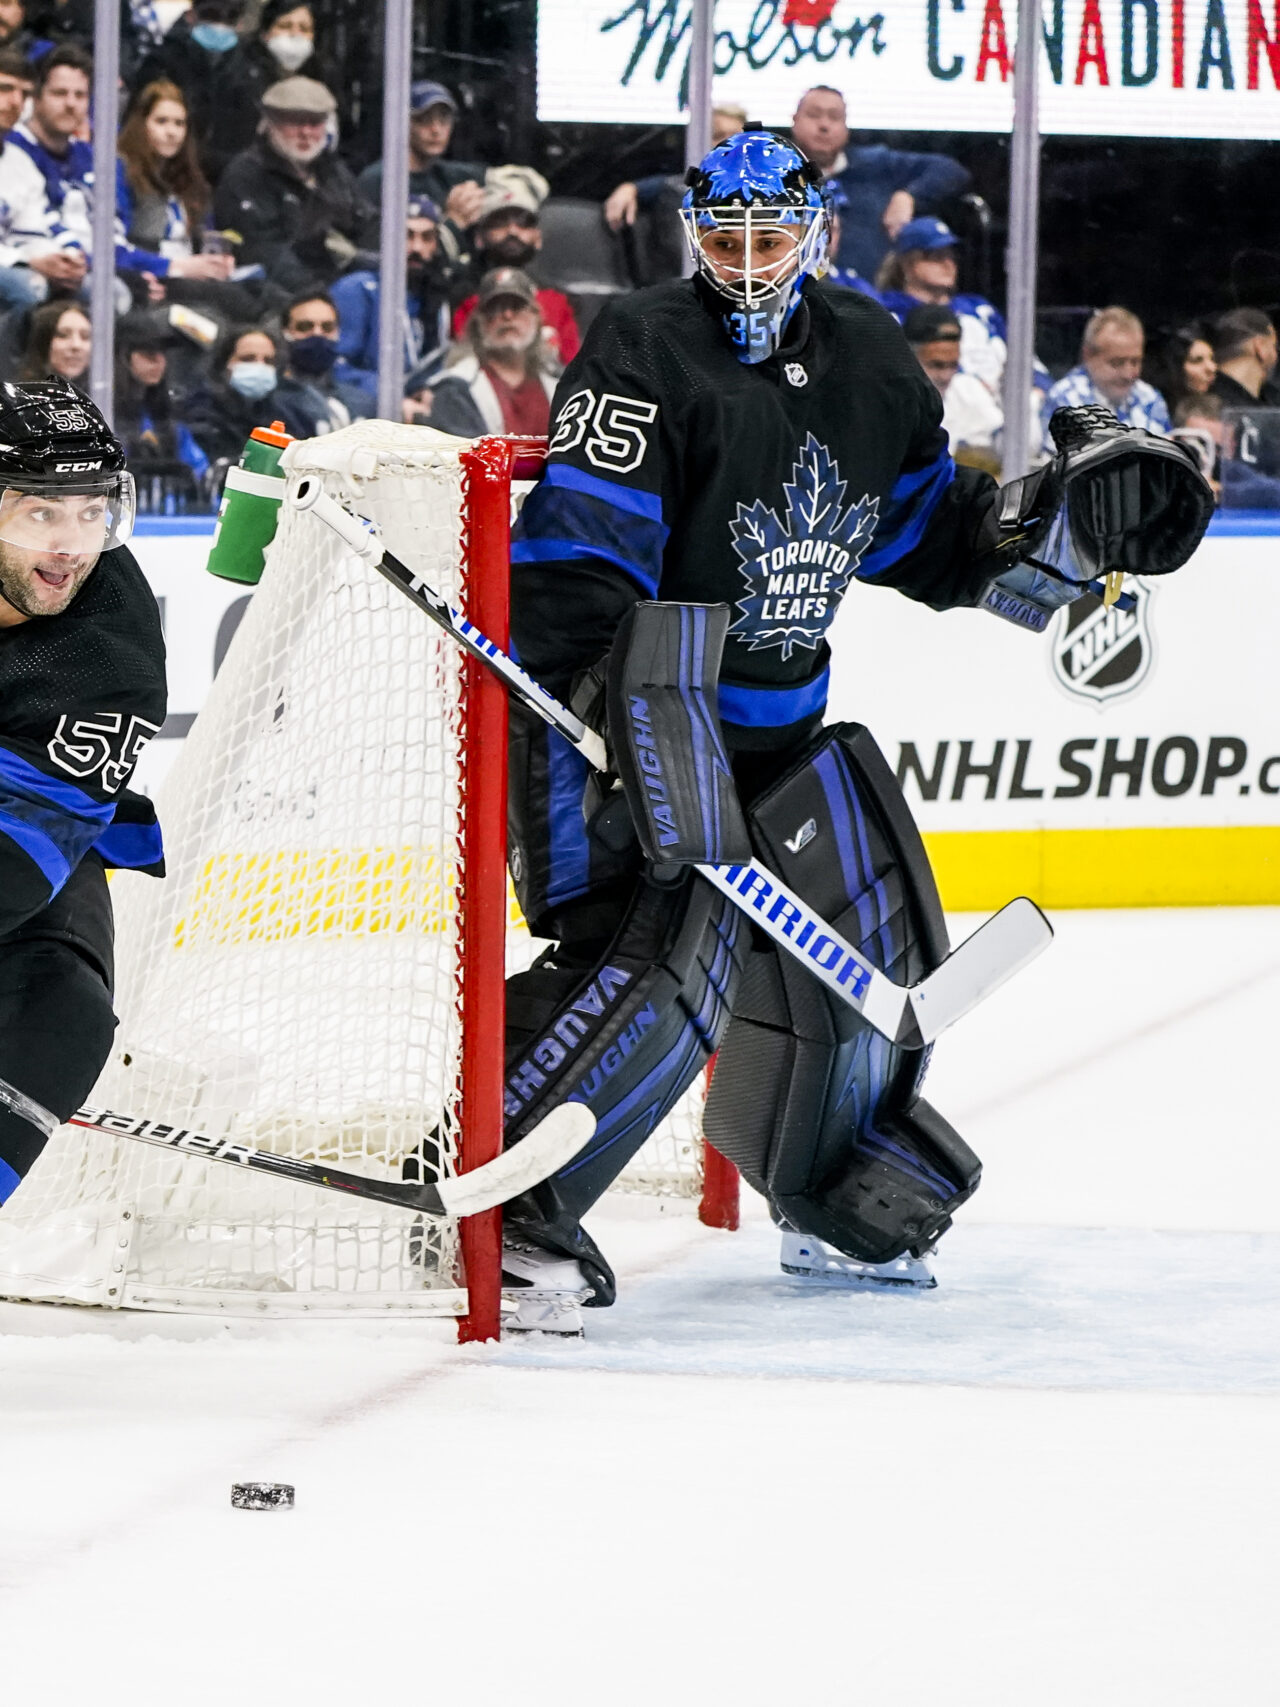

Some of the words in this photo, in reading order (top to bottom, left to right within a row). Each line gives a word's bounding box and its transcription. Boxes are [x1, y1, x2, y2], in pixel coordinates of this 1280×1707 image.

[601, 0, 886, 111] Molson
[730, 312, 768, 346] 35
[49, 410, 88, 431] 55
[548, 388, 658, 474] 35
[55, 460, 103, 473] CCM
[755, 539, 850, 577] TORONTO
[766, 572, 833, 595] MAPLE
[760, 597, 828, 620] LEAFS
[985, 588, 1046, 628] VAUGHN
[1070, 605, 1137, 679] NHL
[46, 712, 163, 795] 55
[628, 694, 681, 847] VAUGHN
